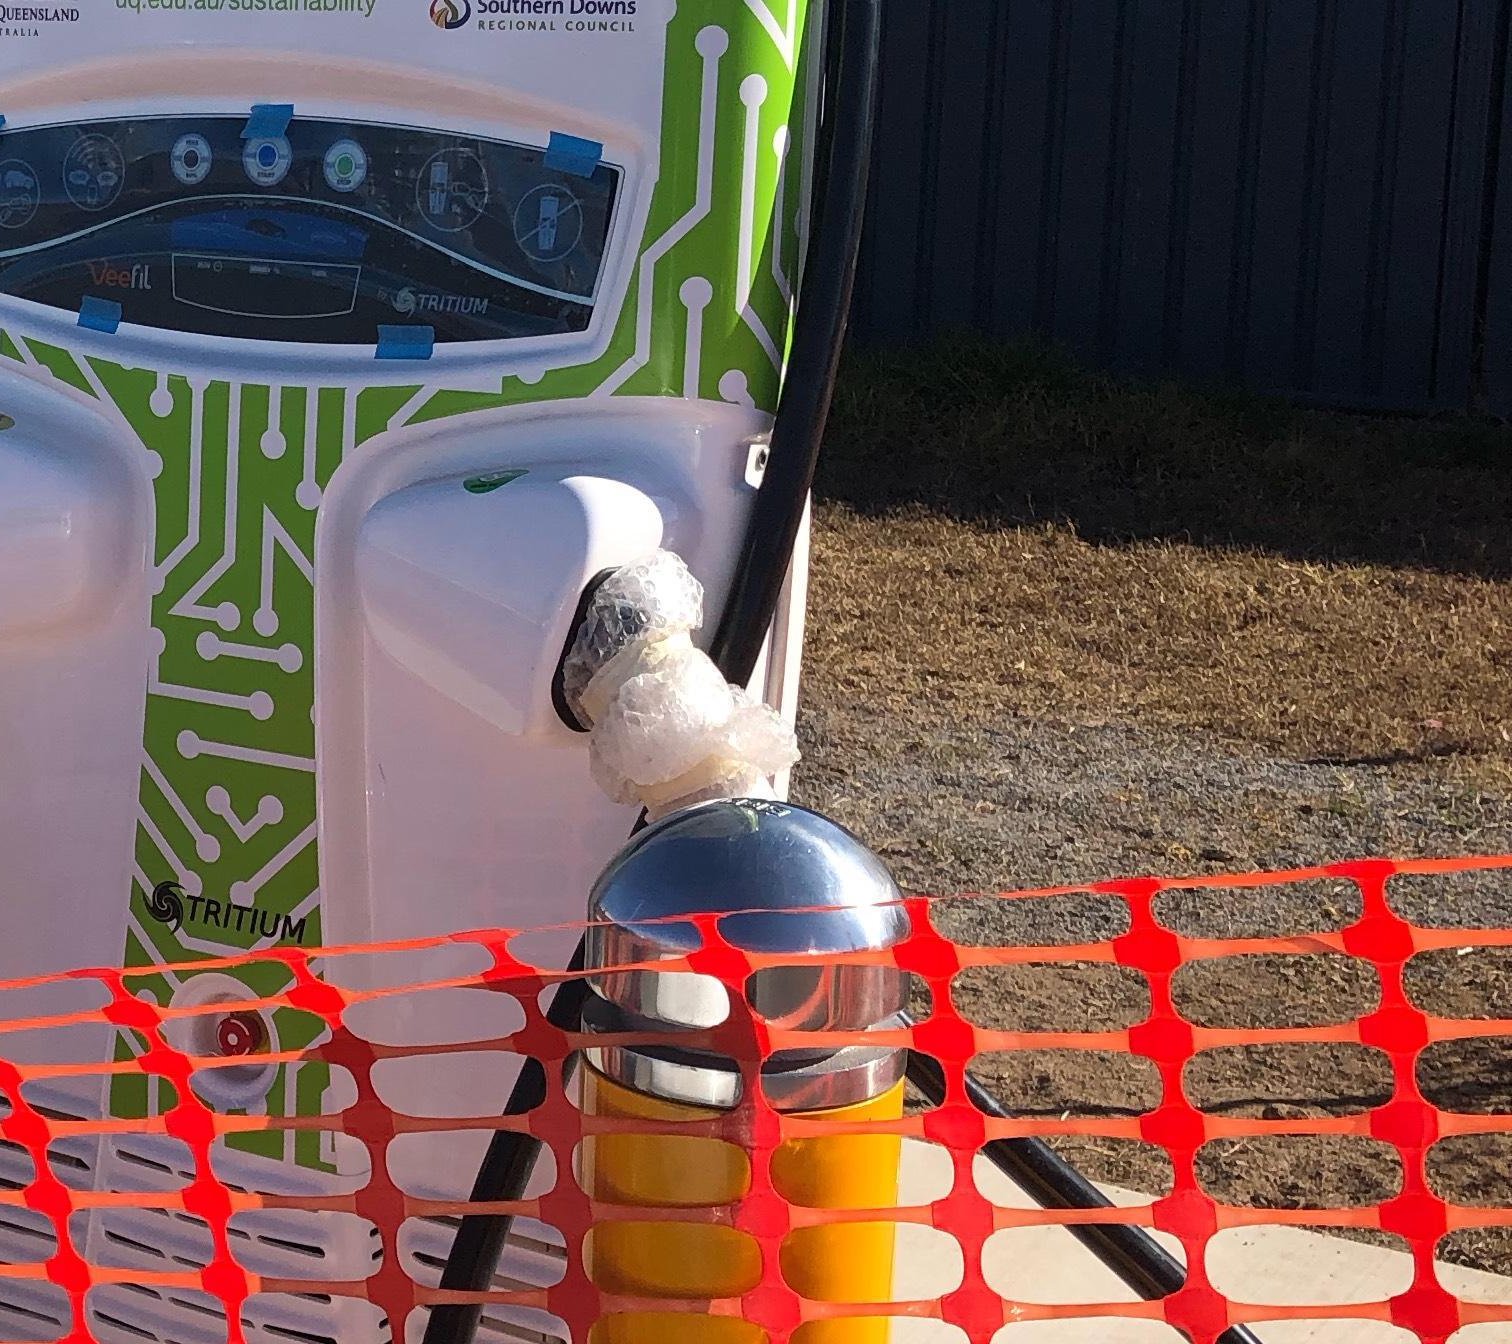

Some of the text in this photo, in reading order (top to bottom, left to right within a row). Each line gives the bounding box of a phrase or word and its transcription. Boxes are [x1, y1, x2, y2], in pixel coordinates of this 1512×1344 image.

[478, 20, 635, 32] REGIONAL COUNCIL
[418, 294, 489, 314] TRITIUM
[187, 895, 306, 944] TRITIUM
